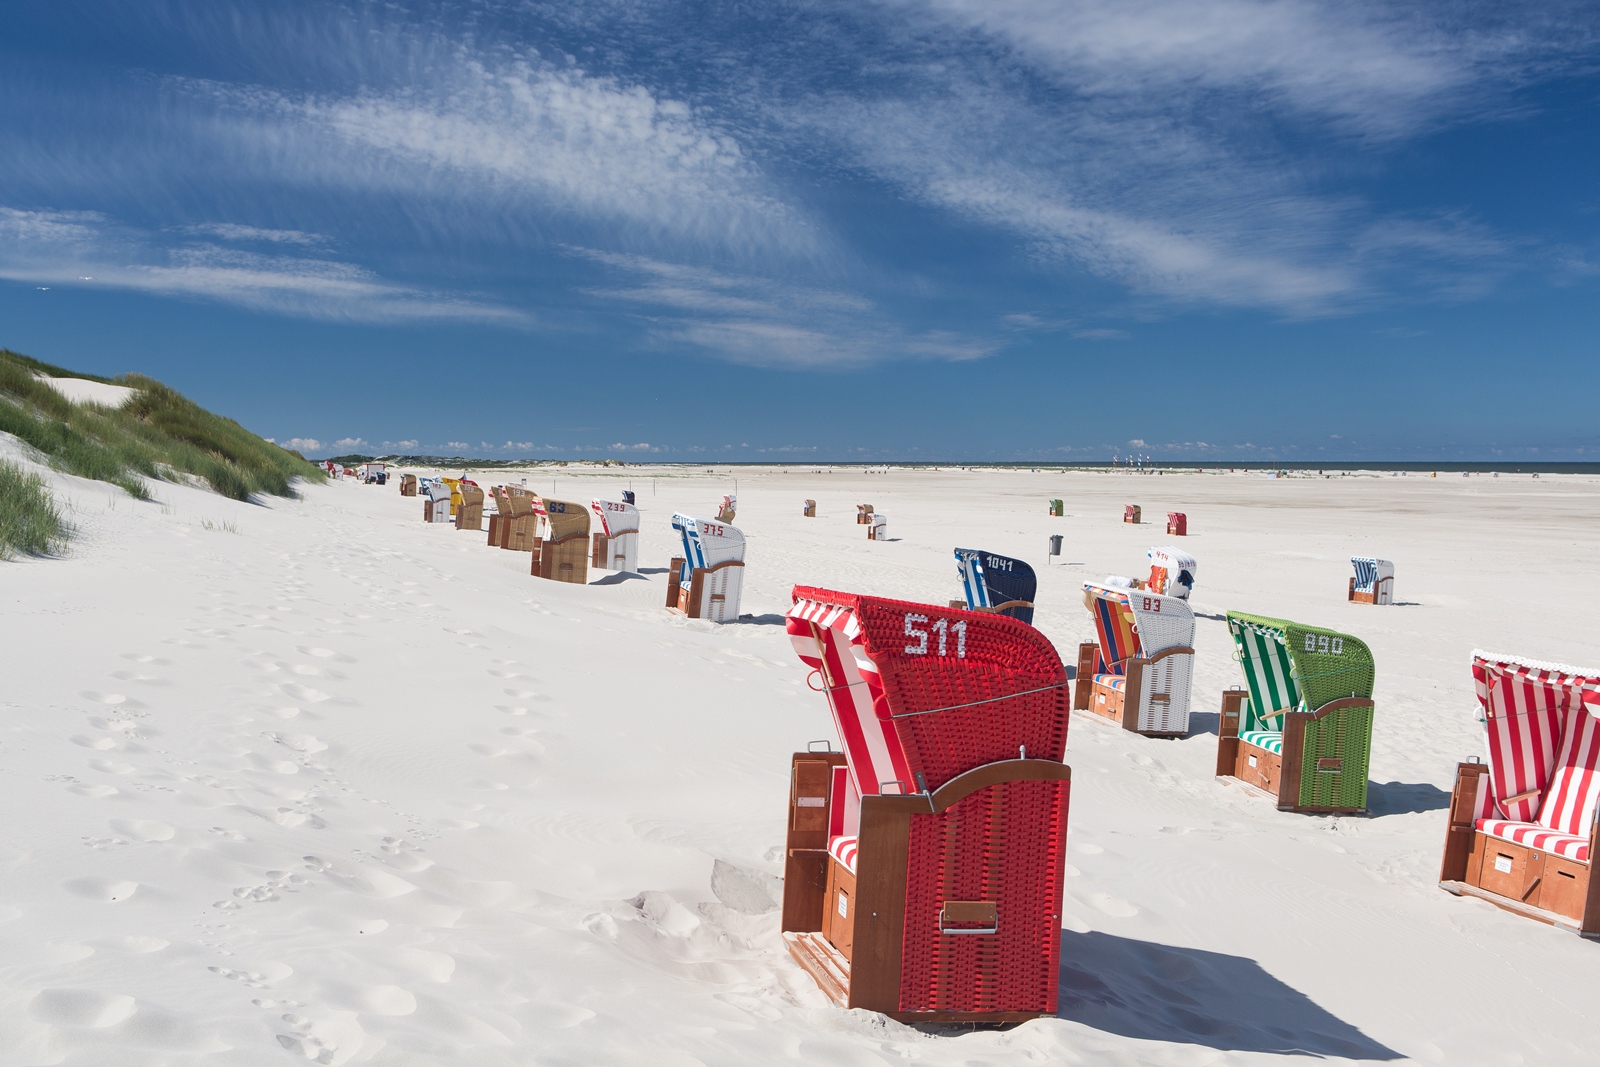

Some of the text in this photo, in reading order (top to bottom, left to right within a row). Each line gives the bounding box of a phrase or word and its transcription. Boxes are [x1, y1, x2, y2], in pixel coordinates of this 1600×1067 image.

[549, 501, 566, 514] 63
[607, 502, 625, 512] 239
[703, 523, 724, 537] 375
[1155, 550, 1169, 561] 414
[986, 555, 1013, 572] 1041
[1143, 597, 1161, 613] 83
[904, 612, 968, 659] 511
[1305, 632, 1344, 655] 890
